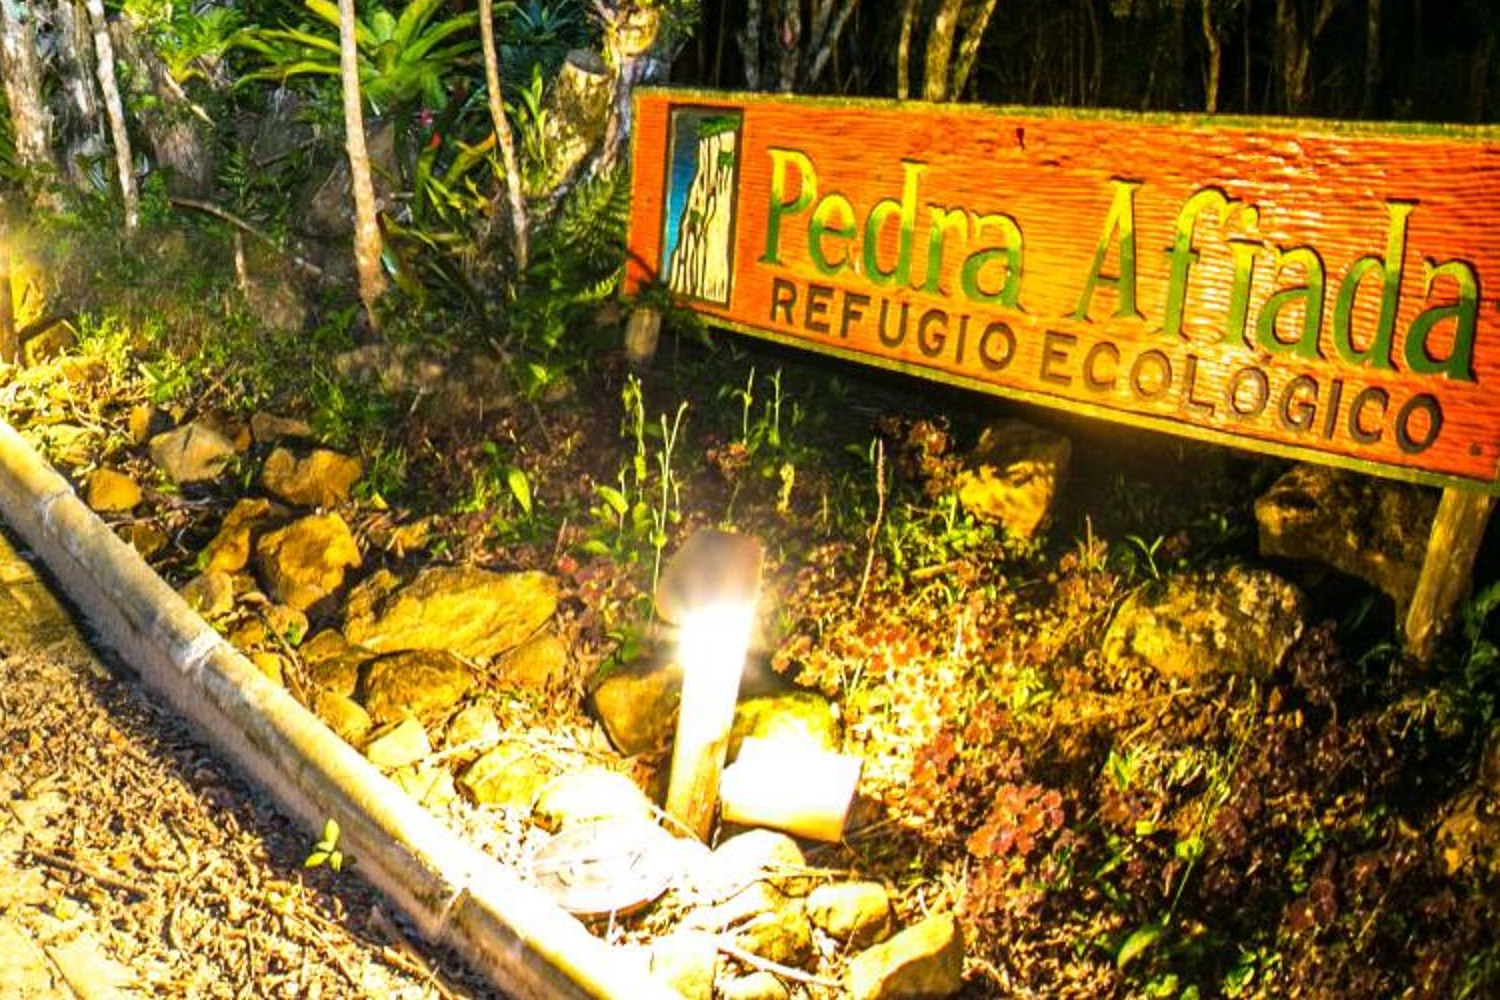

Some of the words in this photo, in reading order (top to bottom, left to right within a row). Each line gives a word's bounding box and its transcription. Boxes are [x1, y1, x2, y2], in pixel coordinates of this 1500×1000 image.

[757, 146, 1027, 313] Pedra
[1060, 174, 1480, 384] Afiada
[769, 276, 1017, 371] REFUGIO
